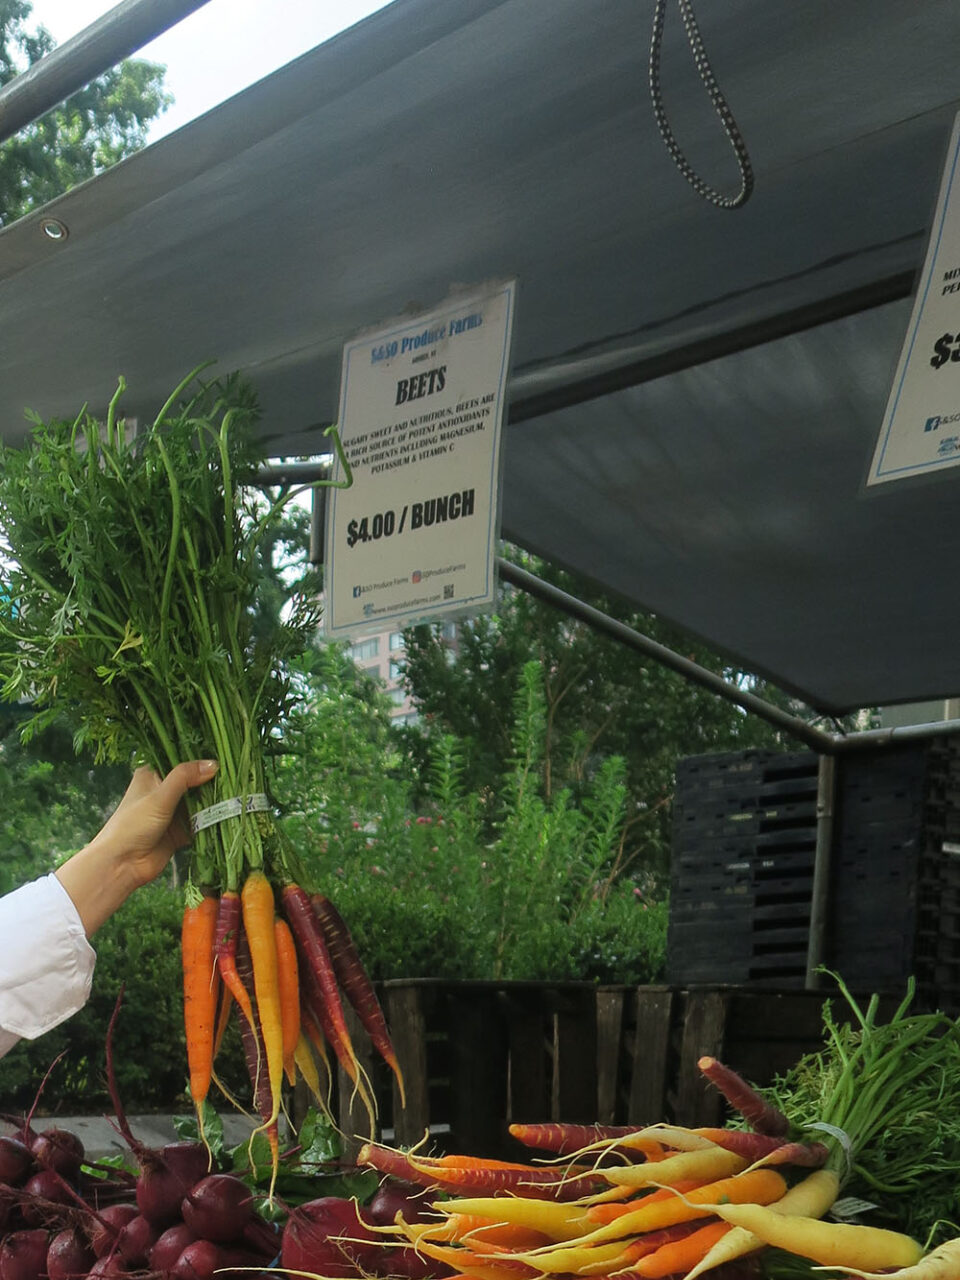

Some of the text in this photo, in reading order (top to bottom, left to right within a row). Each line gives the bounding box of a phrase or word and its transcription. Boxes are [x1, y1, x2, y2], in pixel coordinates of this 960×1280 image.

[401, 327, 447, 354] Produce
[449, 313, 483, 337] Farms
[395, 365, 447, 406] BEETS
[343, 392, 496, 448] SUGARY SWEET AND NUTRITIOUS, BEETS ARE
[351, 446, 368, 458] RICH
[369, 437, 395, 453] SOURCE
[398, 433, 407, 443] OF
[408, 424, 436, 440] POTENT
[437, 407, 491, 431] ANTIOXIDANTS
[361, 447, 399, 465] NUTRIENTS
[400, 435, 439, 455] INCLUDING
[371, 455, 411, 475] POTASSIUM
[419, 445, 448, 462] VITAMIN
[449, 442, 456, 453] C
[347, 488, 476, 549] $4.00 / BUNCH
